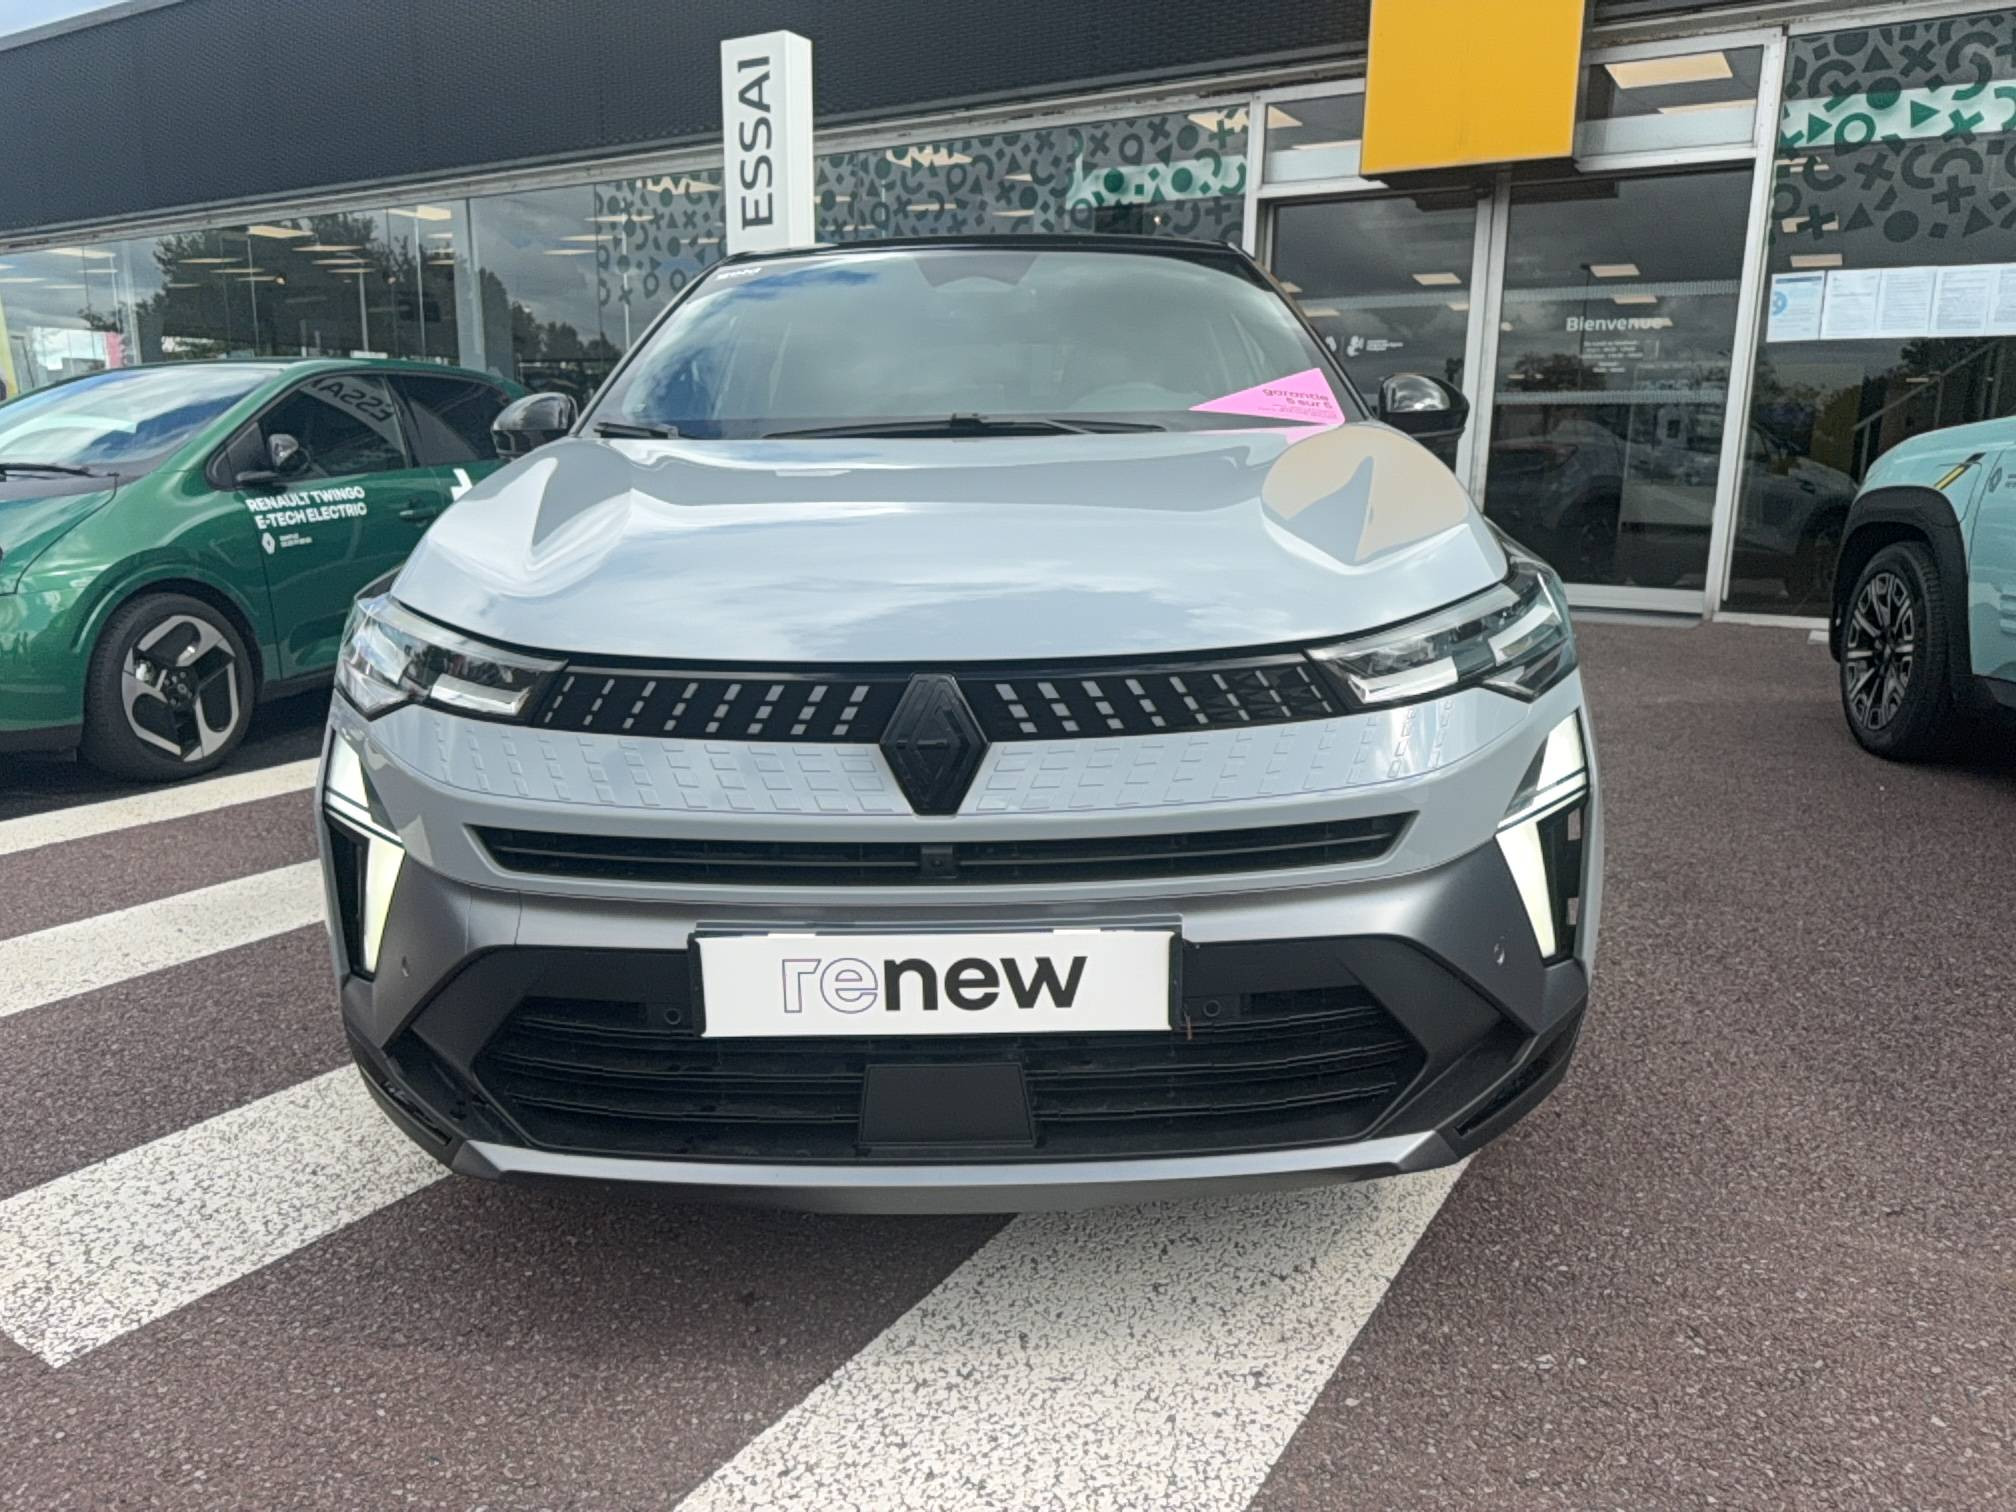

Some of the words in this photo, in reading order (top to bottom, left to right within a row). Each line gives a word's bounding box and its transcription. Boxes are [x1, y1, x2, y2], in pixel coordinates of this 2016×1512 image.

[737, 56, 774, 231] ESSAI
[246, 493, 310, 512] RENAULT
[310, 486, 365, 504] TWINGO
[254, 511, 306, 530] E-TECH
[306, 502, 367, 522] ELECTRIC
[782, 956, 1088, 1014] renew
